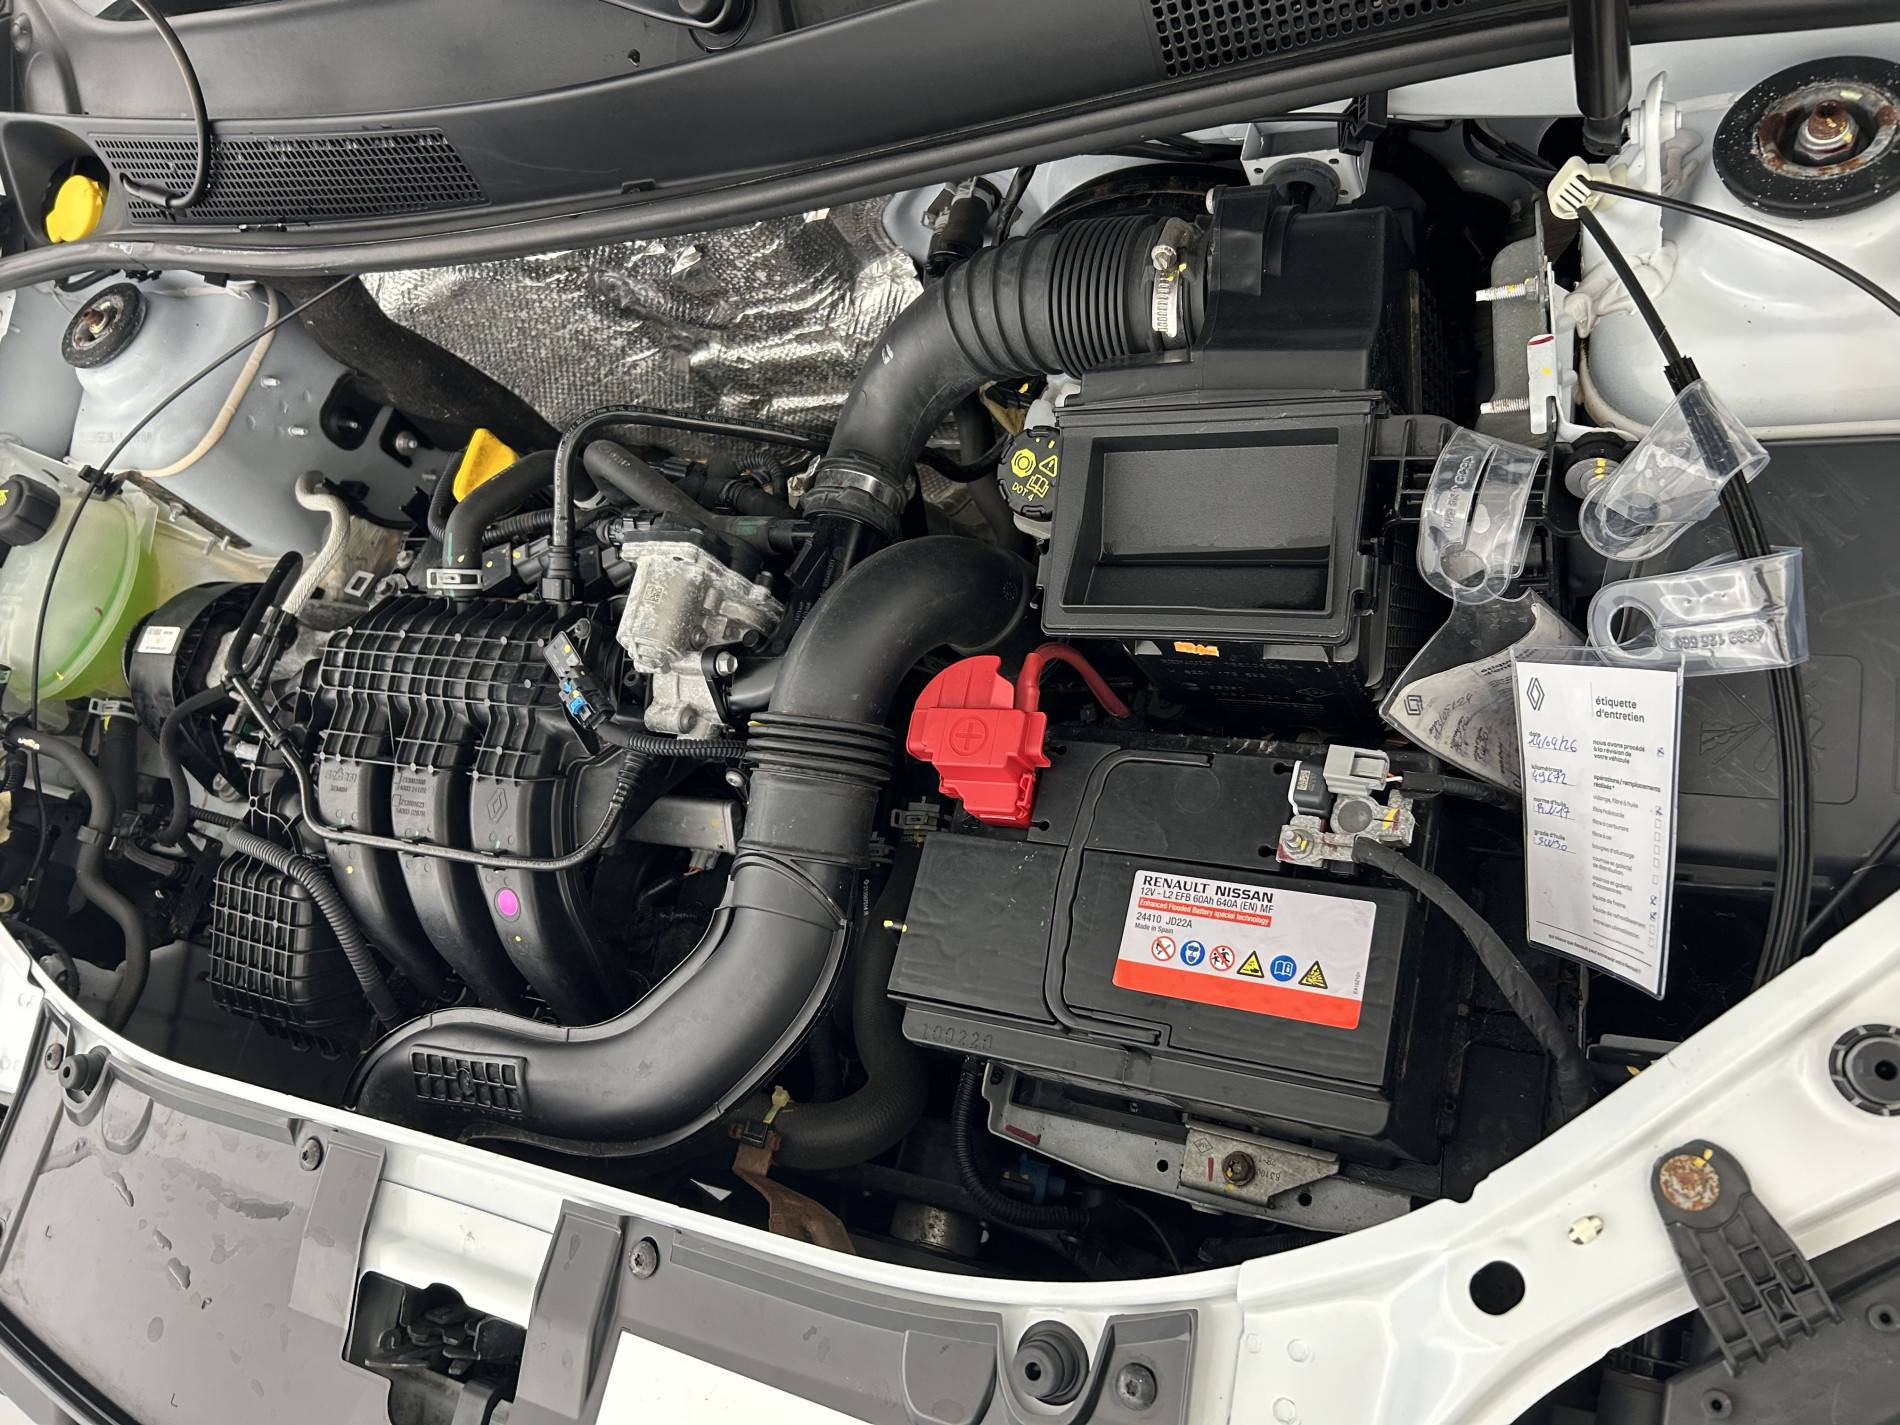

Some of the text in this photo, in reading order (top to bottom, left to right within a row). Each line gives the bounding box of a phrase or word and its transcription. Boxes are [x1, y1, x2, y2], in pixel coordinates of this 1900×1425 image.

[1012, 482, 1028, 496] DOT
[1596, 696, 1637, 709] étiquette
[1596, 708, 1644, 723] d'entretien
[1143, 875, 1274, 903] RENAULT NISSAN
[1141, 887, 1155, 896] 12V
[1163, 890, 1173, 899] L2
[1175, 892, 1190, 901] EFB
[1193, 894, 1214, 906] 60Ah
[1216, 897, 1238, 908] 640A
[1240, 900, 1257, 913] (EN)
[1260, 903, 1274, 914] MF
[1140, 898, 1269, 926] Enhanced Flooded Battery special technology
[1136, 912, 1193, 928] 24410 JD22A
[1135, 922, 1150, 930] Made
[1158, 925, 1174, 934] Spain
